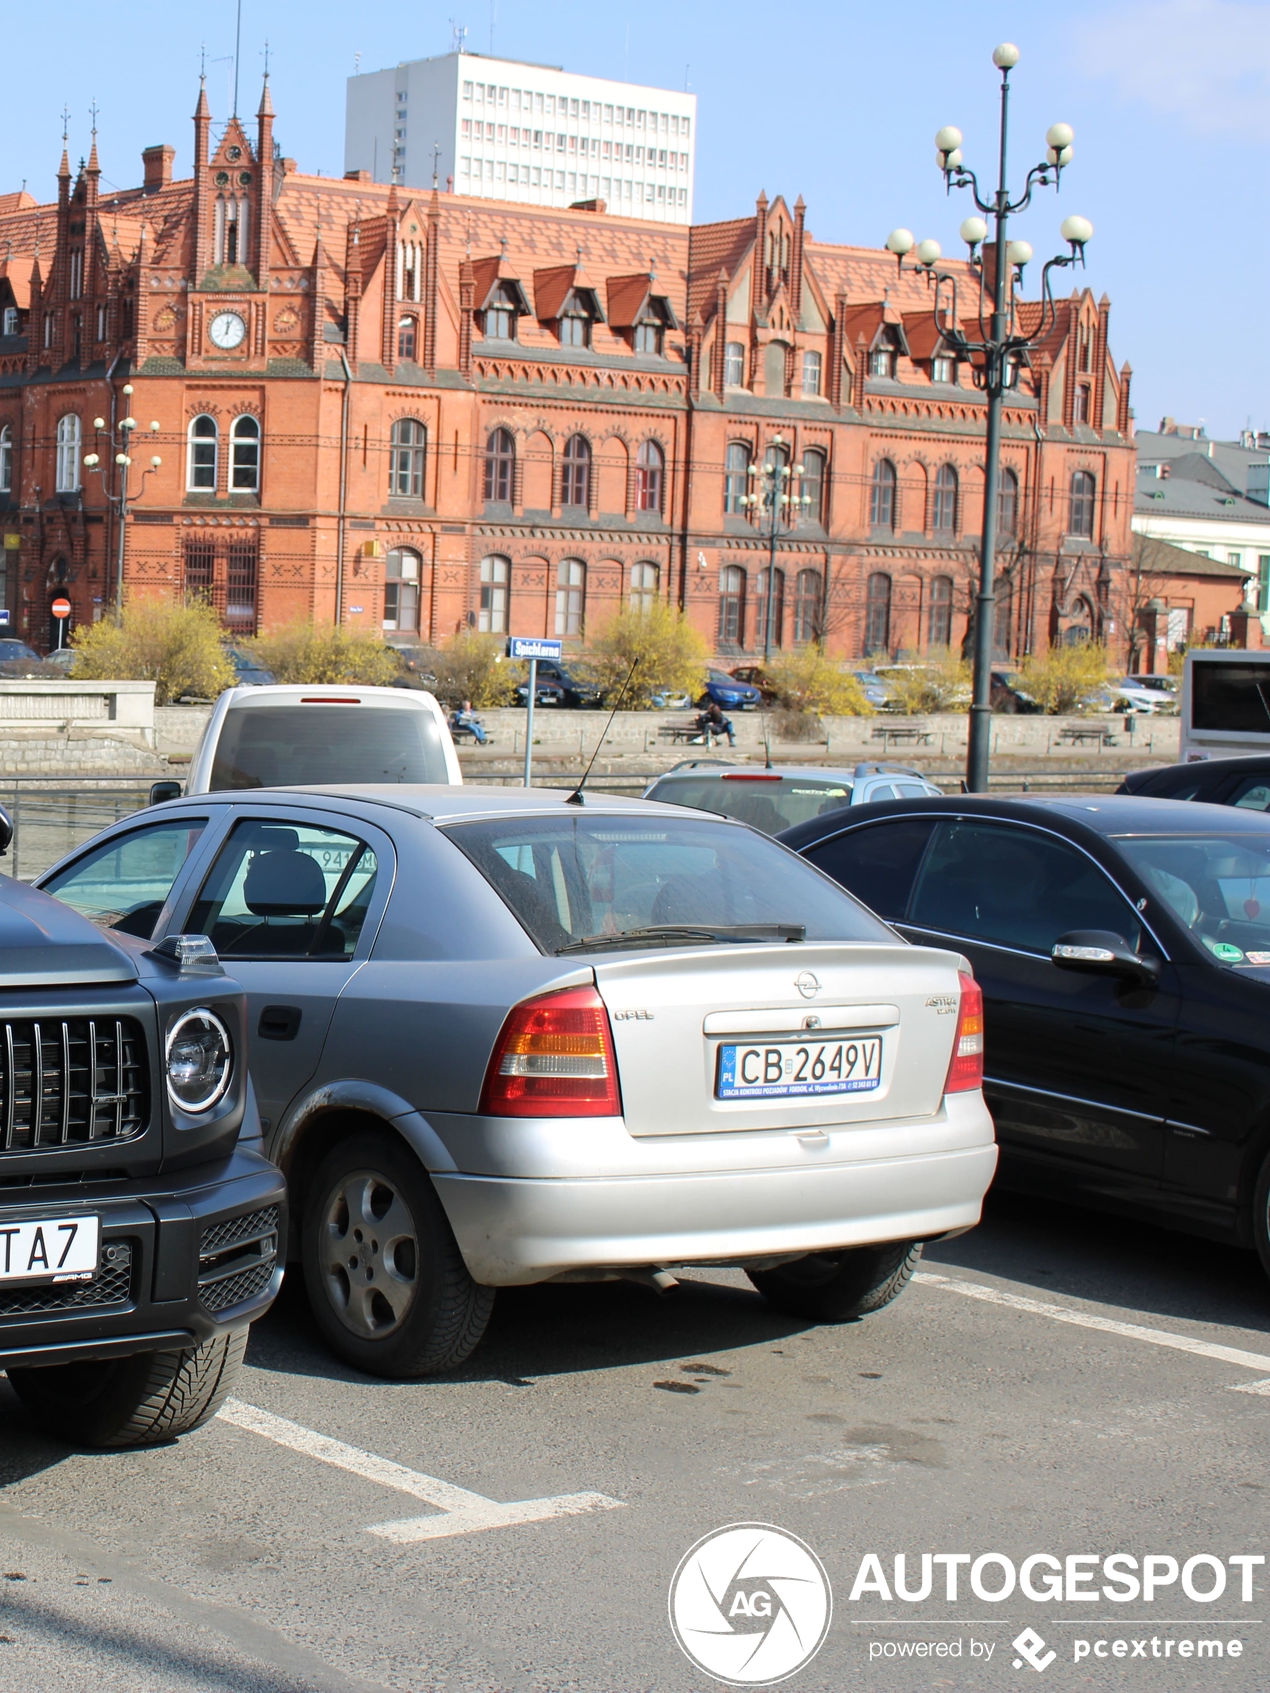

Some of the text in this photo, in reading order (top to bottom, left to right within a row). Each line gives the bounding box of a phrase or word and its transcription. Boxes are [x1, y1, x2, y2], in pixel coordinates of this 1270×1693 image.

[515, 640, 560, 657] Spichlerna
[925, 996, 957, 1007] ASTRA
[614, 1009, 654, 1020] OPEL
[740, 1042, 877, 1085] CB 2649V
[722, 1072, 734, 1083] PL
[723, 1088, 739, 1096] STACJA
[739, 1087, 762, 1095] KONTROLI
